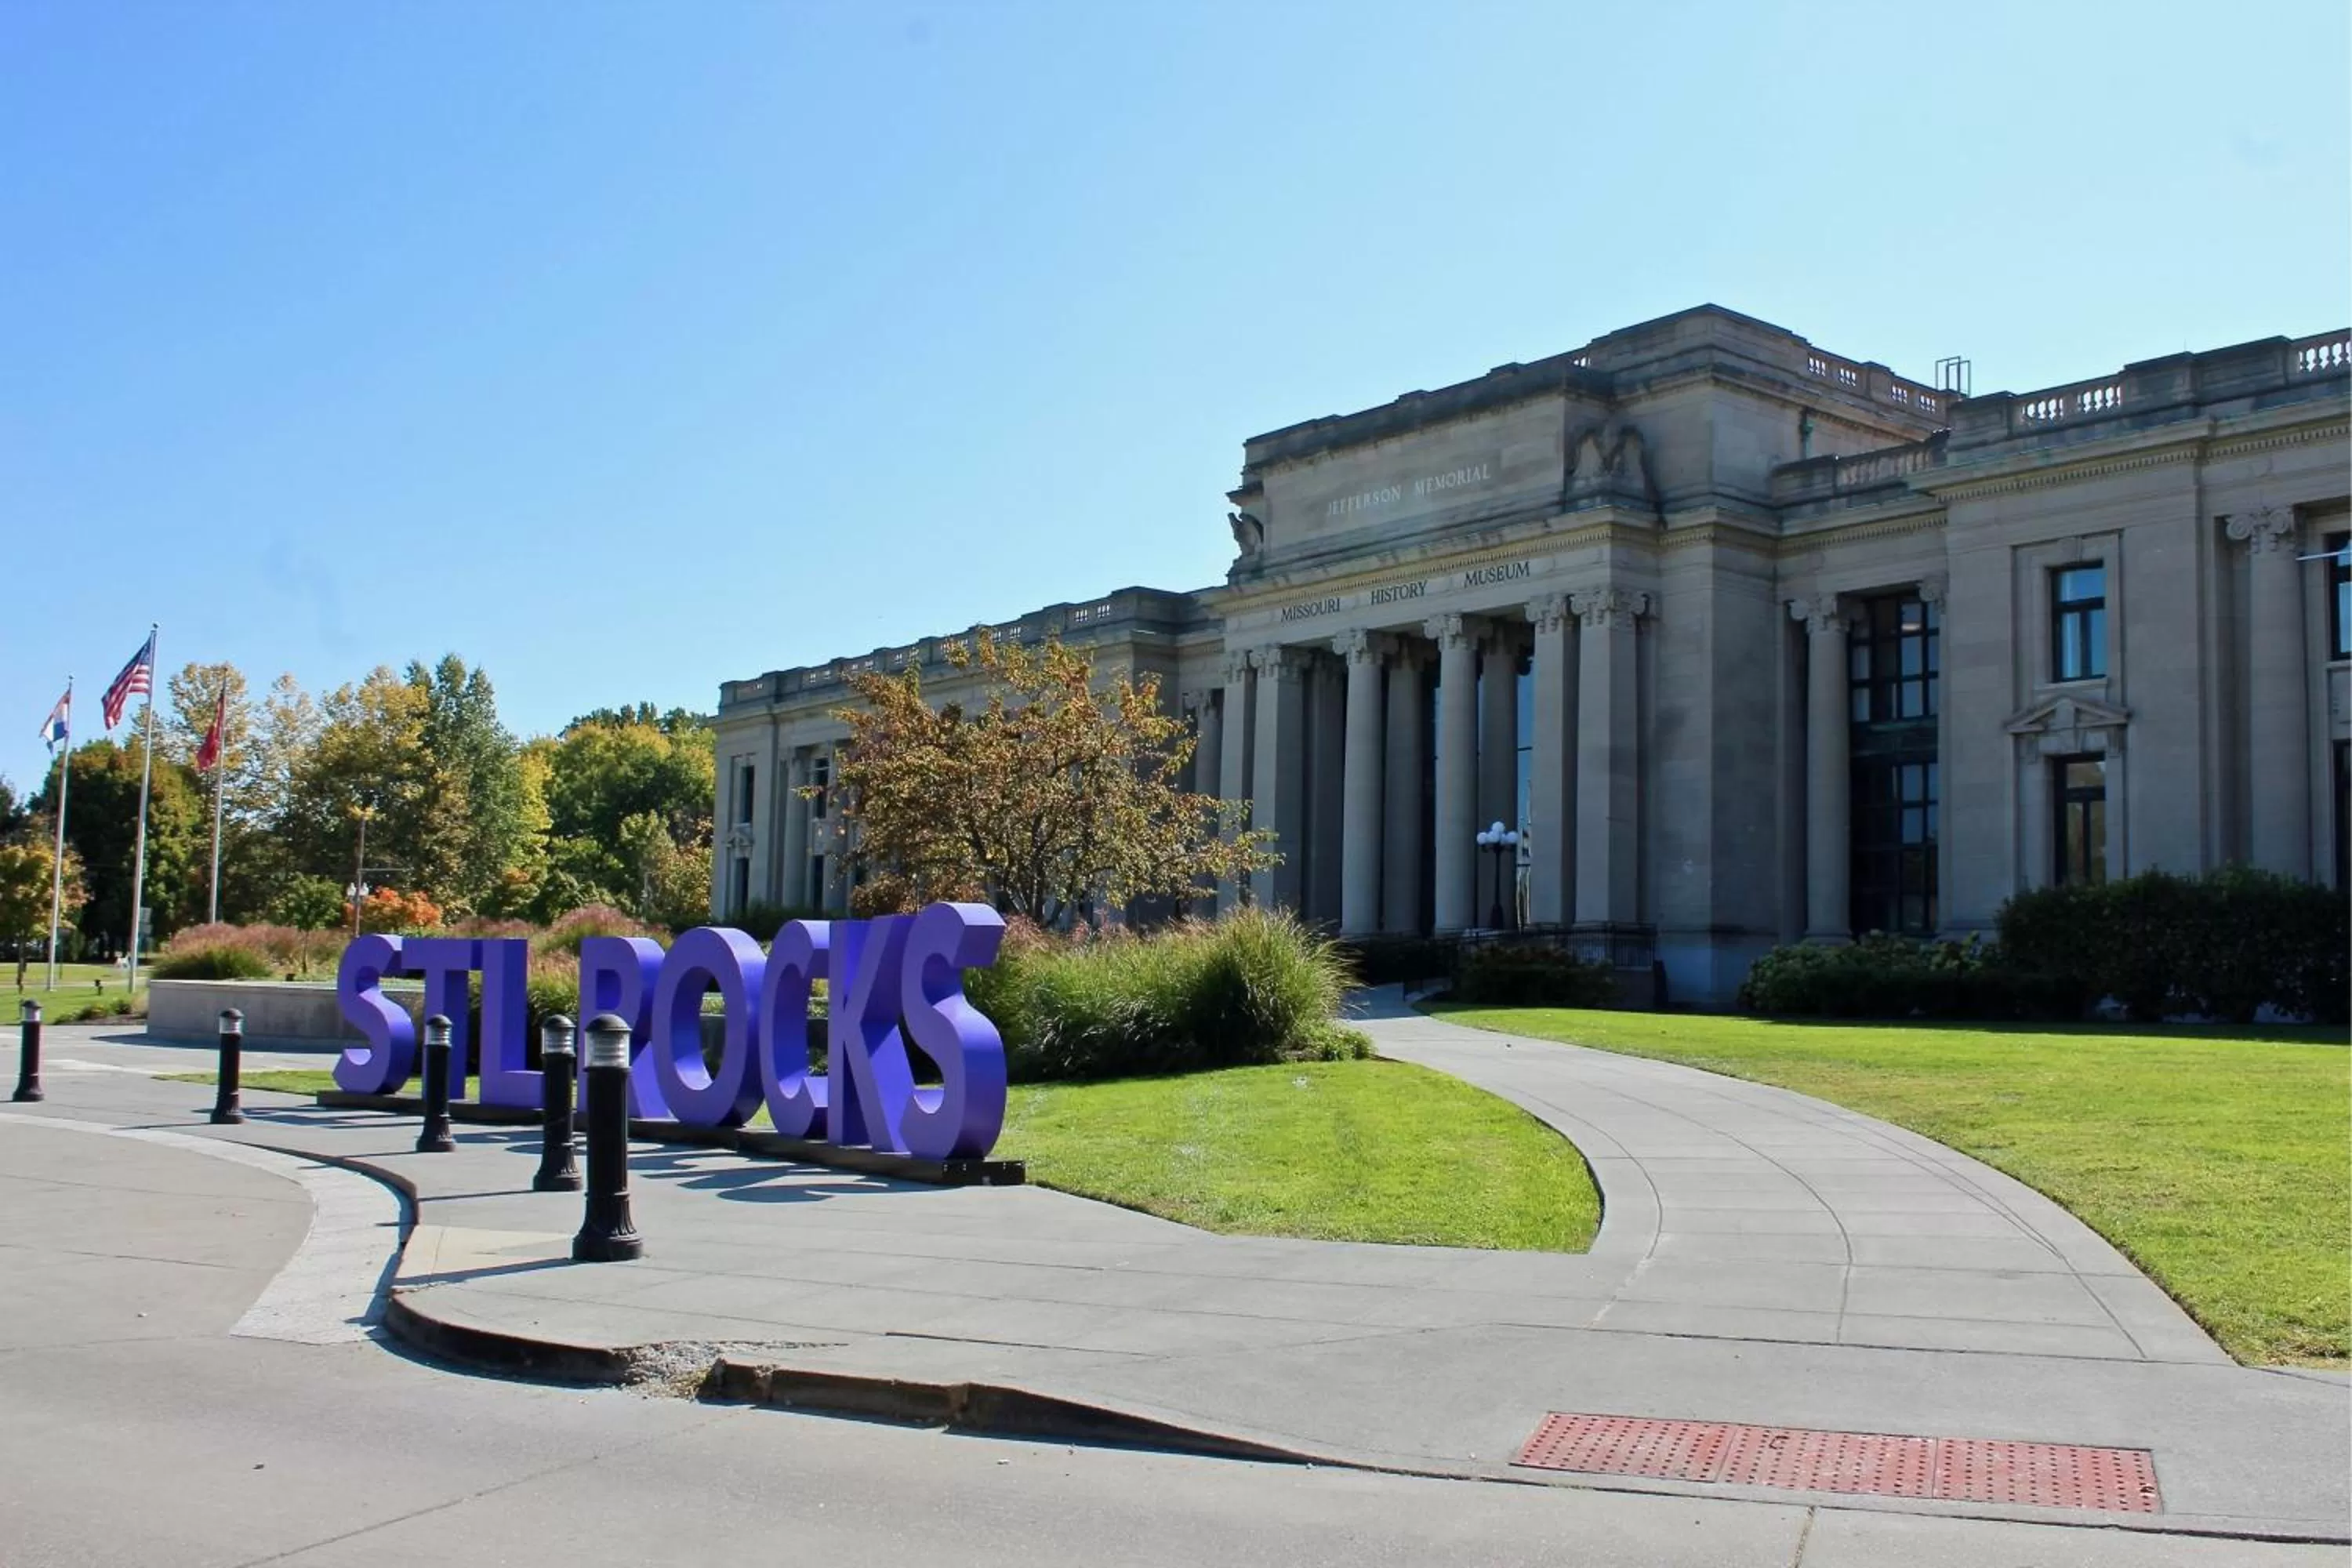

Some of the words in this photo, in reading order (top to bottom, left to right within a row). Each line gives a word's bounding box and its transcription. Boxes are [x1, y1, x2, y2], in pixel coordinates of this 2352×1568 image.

[1327, 485, 1402, 517] JEFFERSON
[1414, 463, 1490, 498] MEMORIAL
[1280, 597, 1340, 622] MISSOURI
[1371, 579, 1427, 605] HISTORY
[1464, 561, 1530, 588] MUSEUM
[332, 934, 545, 1110] STL
[579, 902, 1007, 1161] ROCKS
